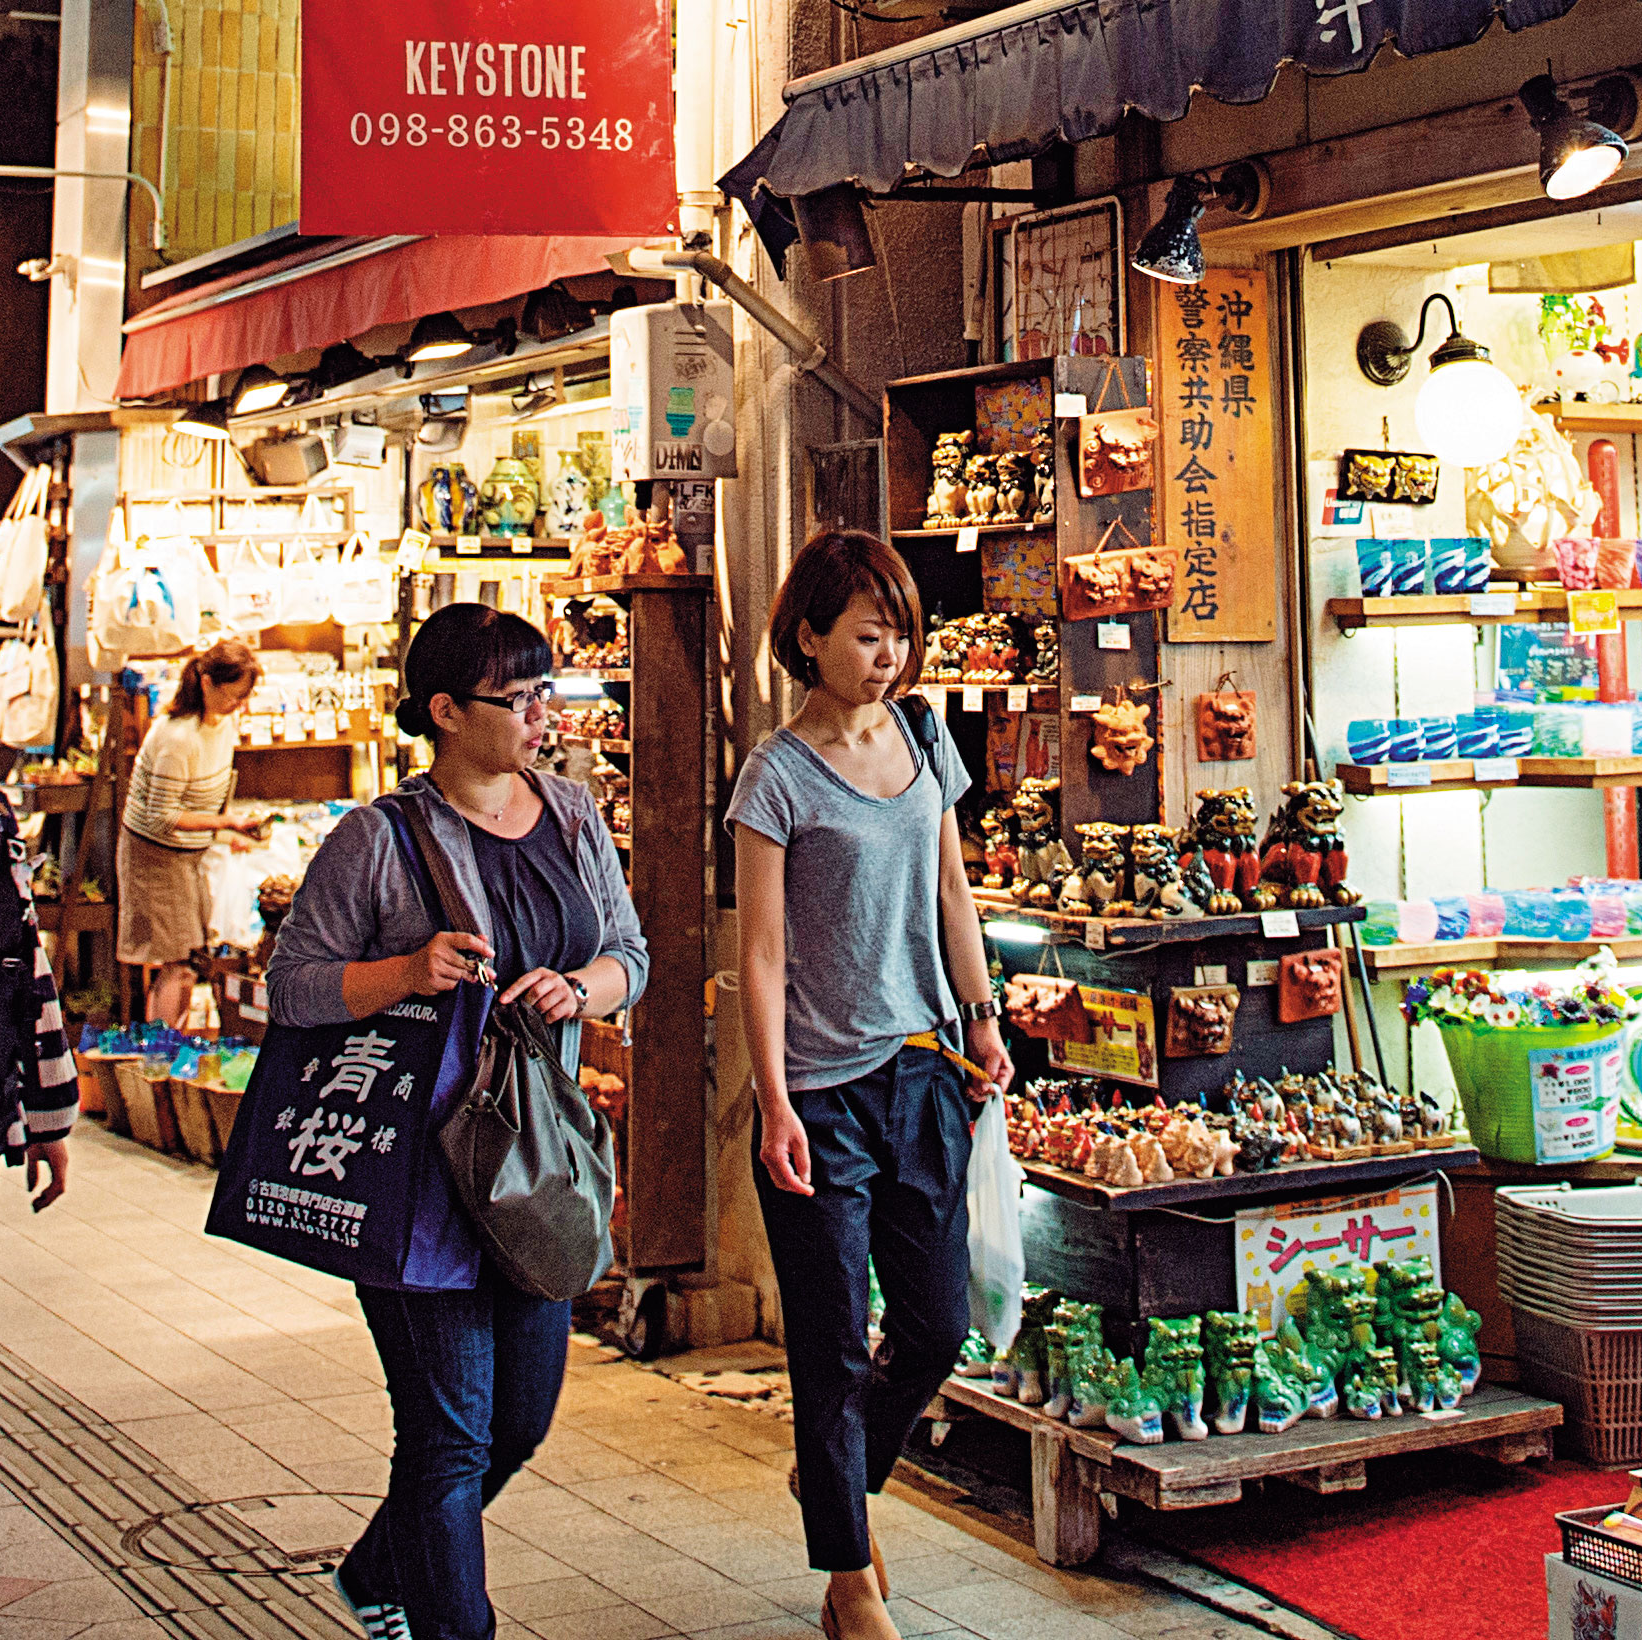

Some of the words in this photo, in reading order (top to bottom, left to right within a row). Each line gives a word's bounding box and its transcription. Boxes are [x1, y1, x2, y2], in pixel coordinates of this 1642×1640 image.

[405, 41, 588, 101] KEYSTONE
[350, 112, 635, 153] 098-863-5348
[1215, 289, 1257, 418] 沖縄県
[1173, 283, 1220, 621] 警察共助会指定店
[288, 1028, 398, 1182] 青桜
[1265, 1213, 1416, 1274] シーサー
